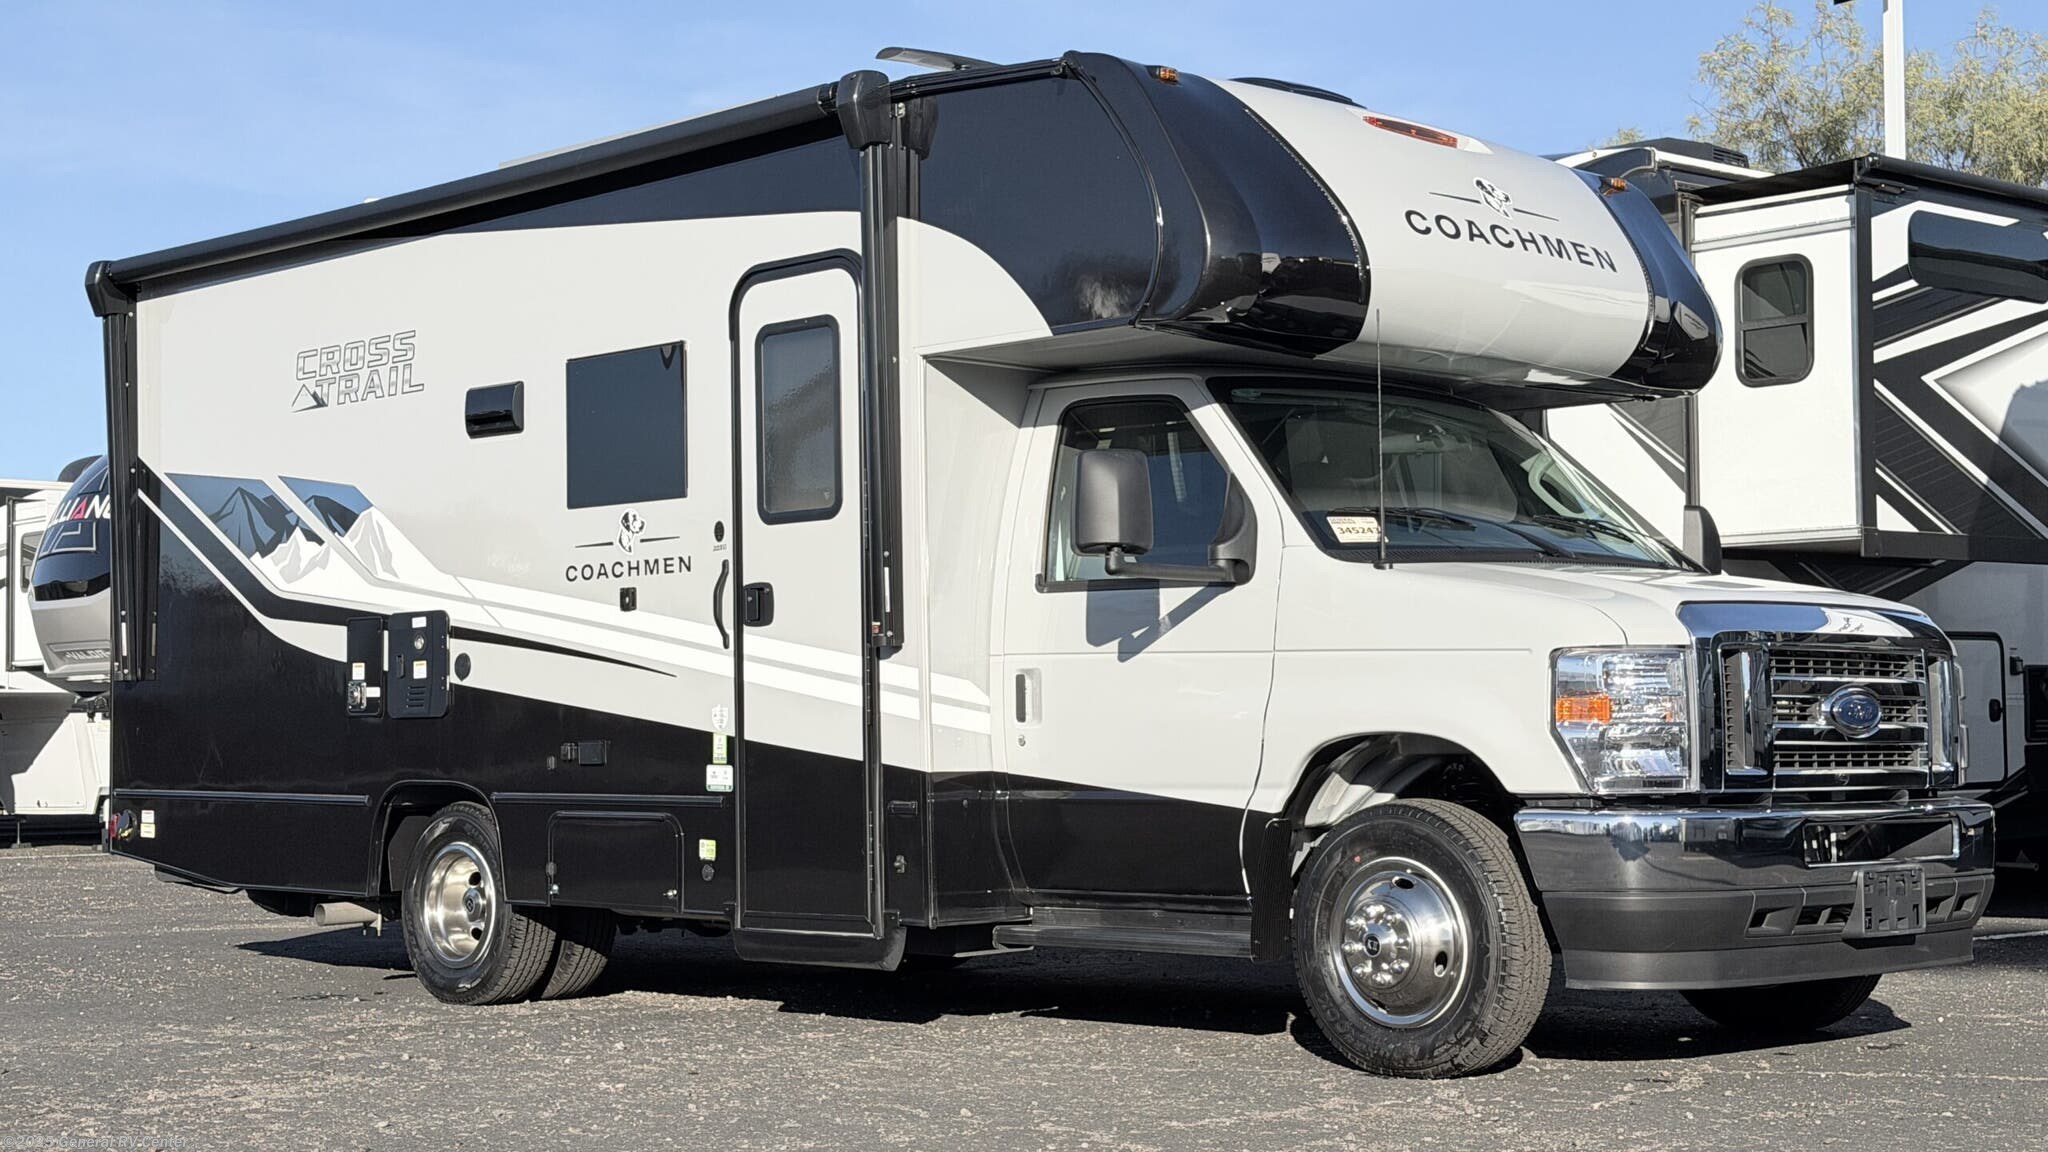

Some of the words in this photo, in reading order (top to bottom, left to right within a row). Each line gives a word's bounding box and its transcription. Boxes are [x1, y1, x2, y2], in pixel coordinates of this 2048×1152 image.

[1404, 209, 1618, 273] COACHMEN
[296, 330, 416, 381] CROSS
[315, 363, 425, 407] TRAIL
[565, 555, 692, 582] COACHMEN
